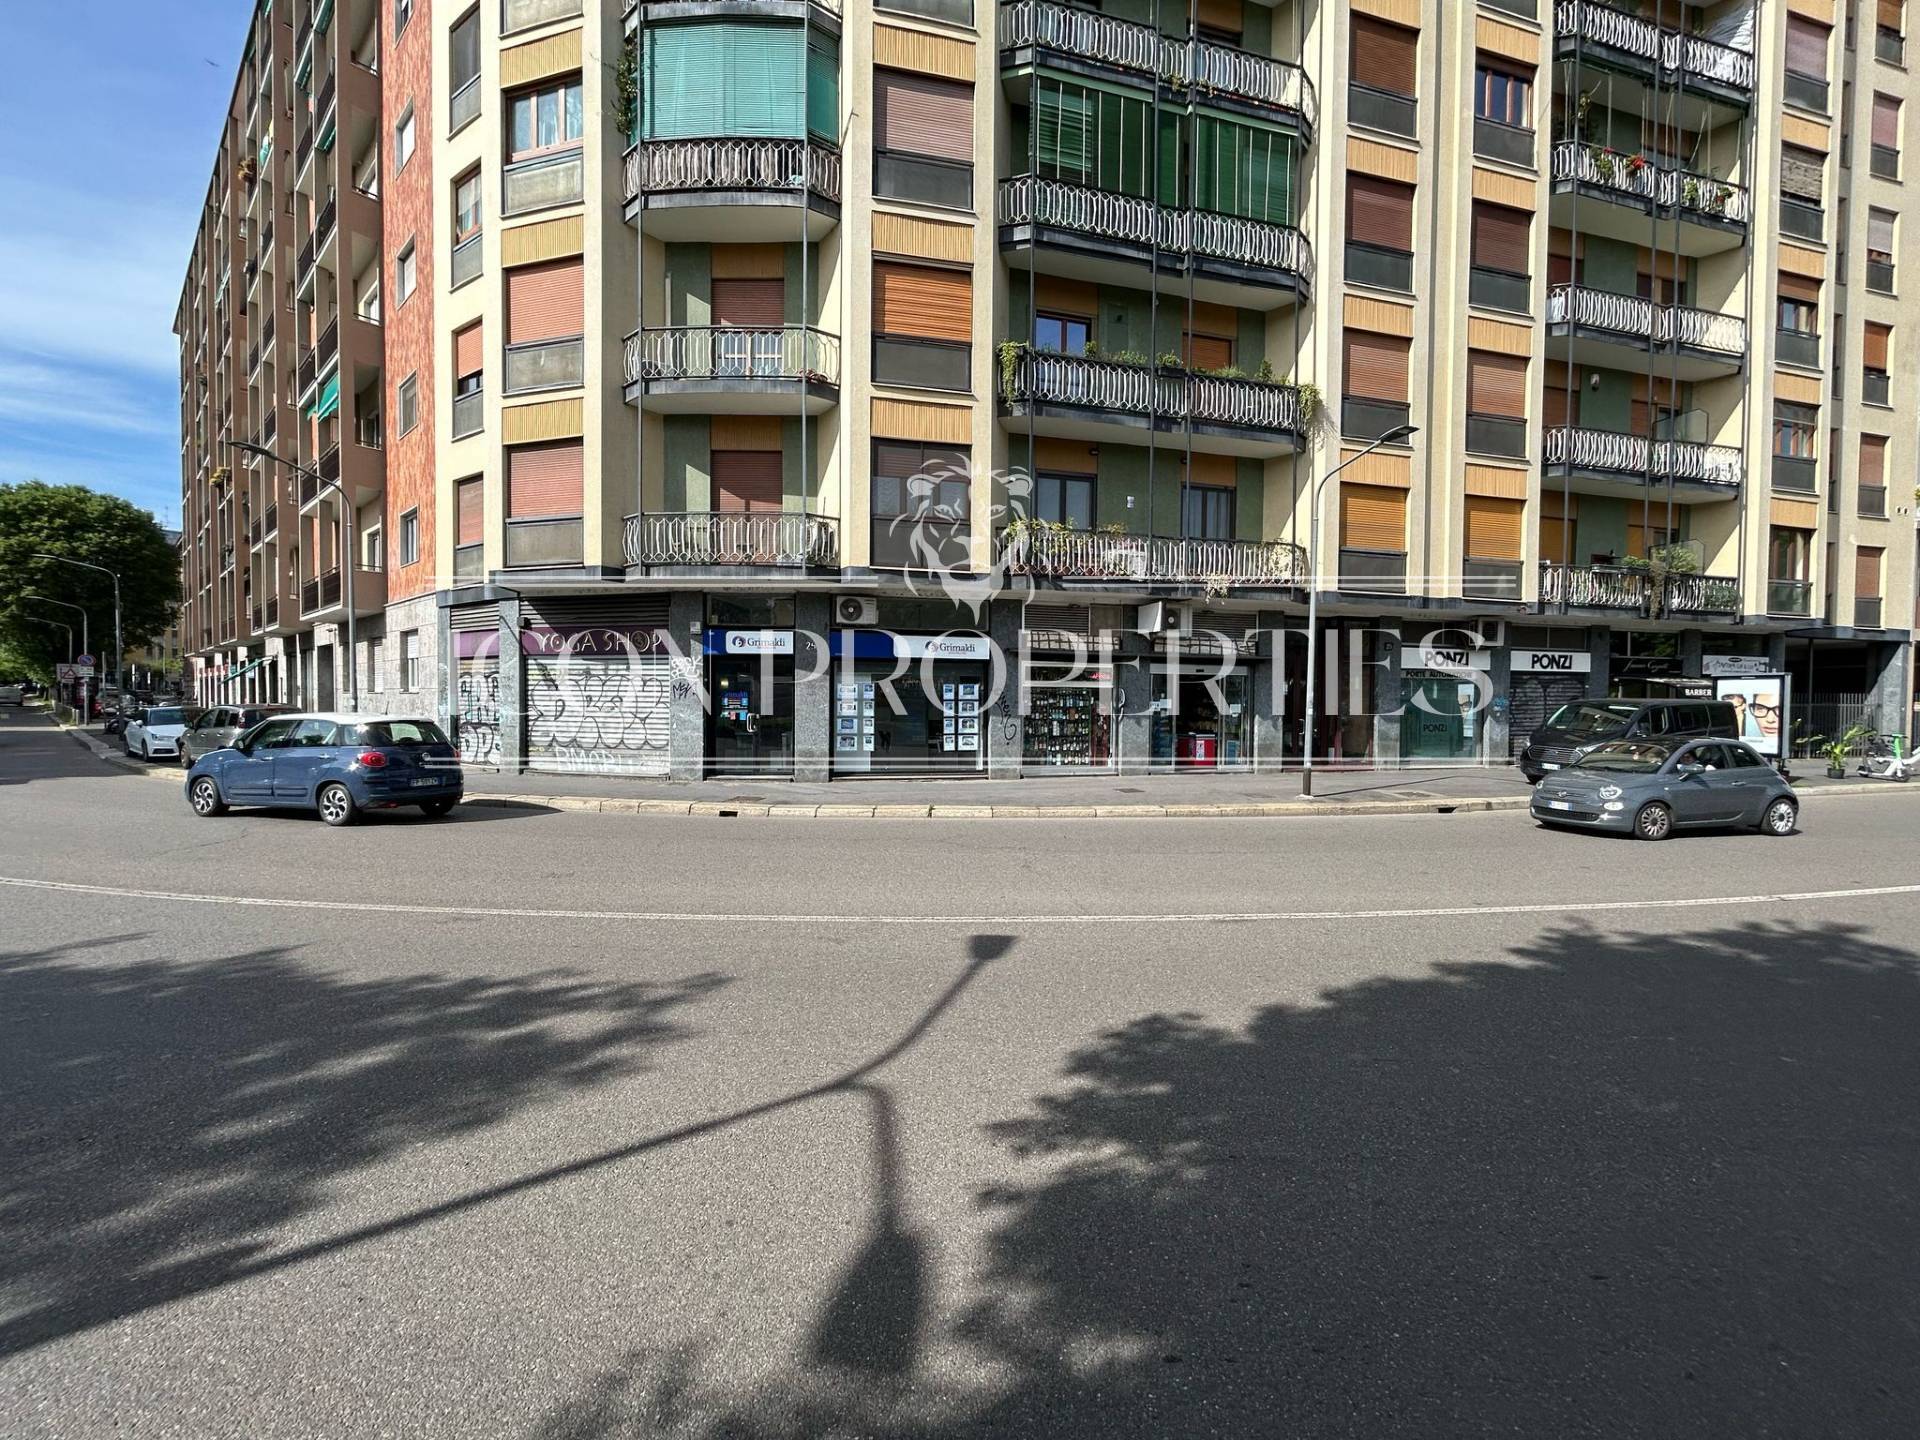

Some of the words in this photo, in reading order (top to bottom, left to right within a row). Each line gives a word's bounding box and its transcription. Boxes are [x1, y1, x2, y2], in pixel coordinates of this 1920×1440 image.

[540, 632, 597, 652] YOGA
[604, 630, 662, 652] SHOP
[747, 637, 786, 647] Grimaldi
[939, 642, 976, 652] Grimaldi
[1424, 651, 1470, 667] PONZI
[1531, 653, 1573, 669] PONZI
[1684, 688, 1712, 696] BARBER
[1423, 724, 1448, 733] PONZI
